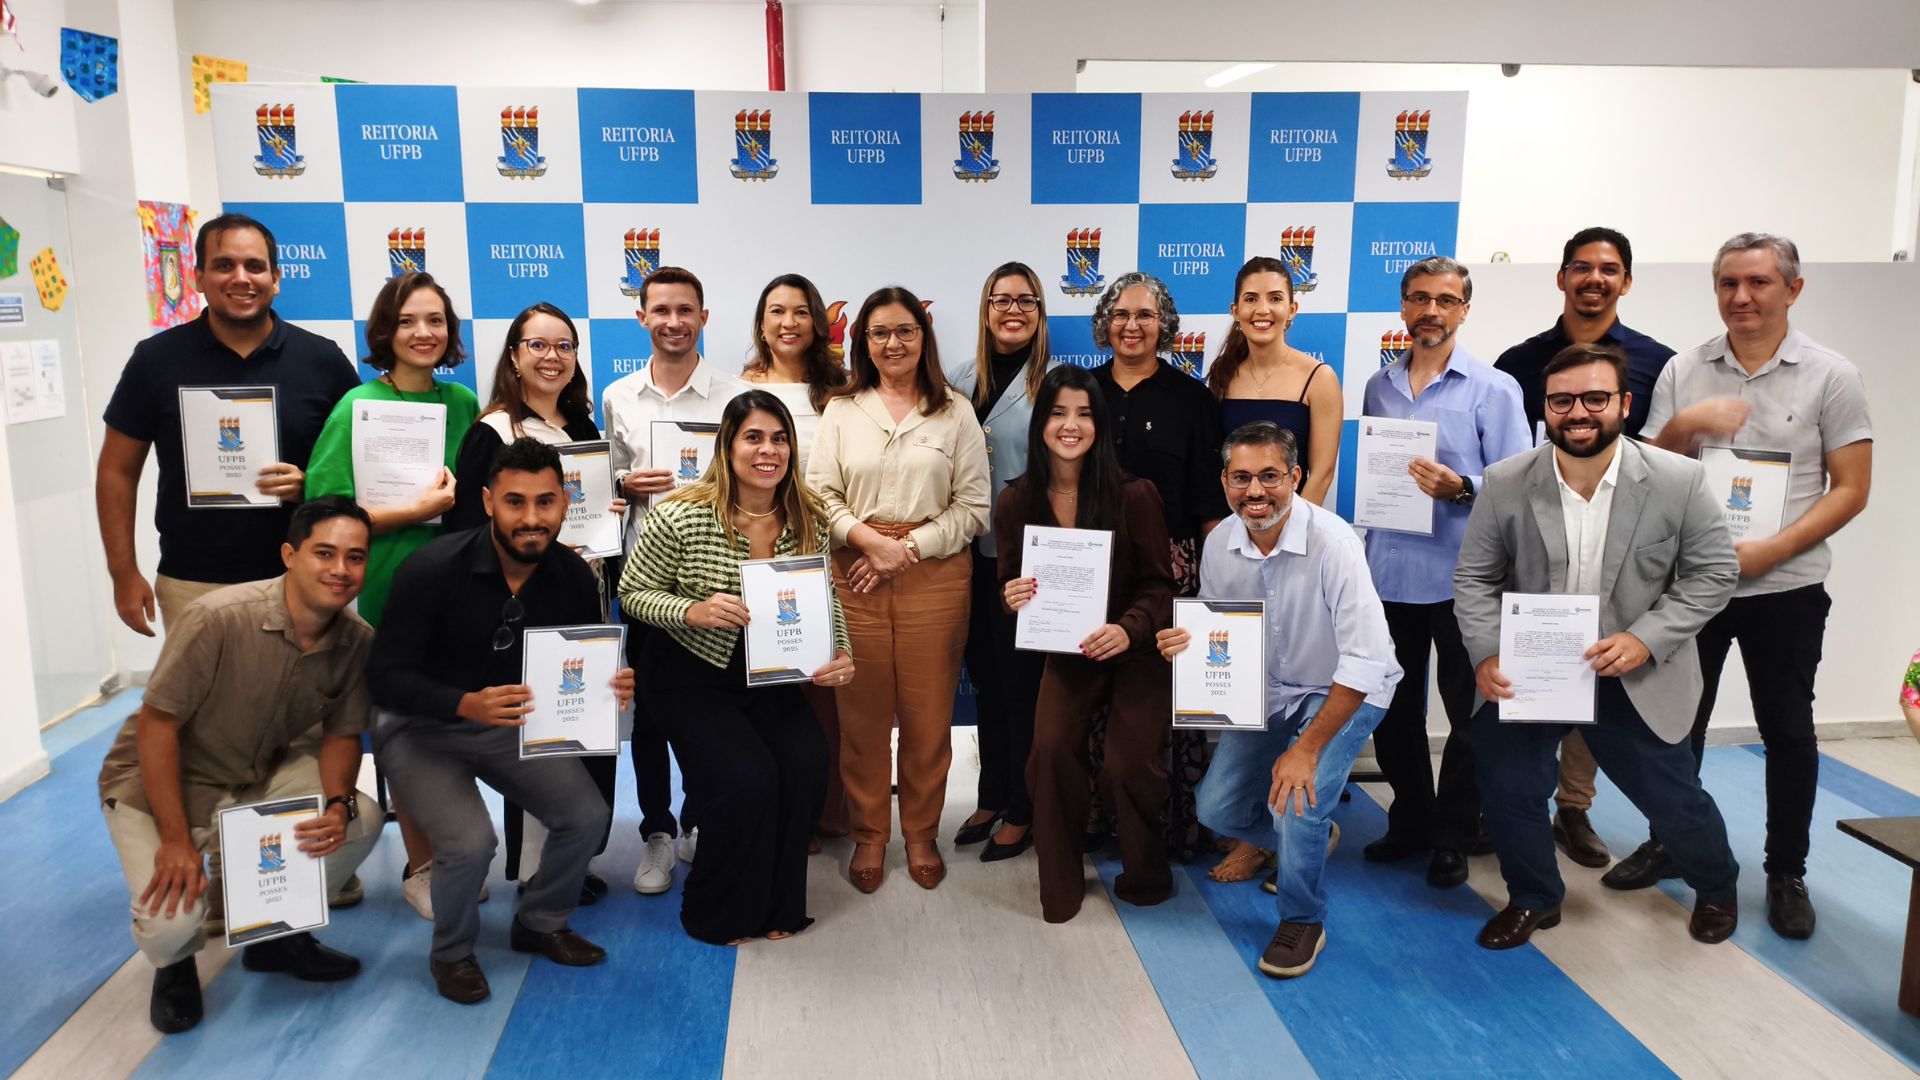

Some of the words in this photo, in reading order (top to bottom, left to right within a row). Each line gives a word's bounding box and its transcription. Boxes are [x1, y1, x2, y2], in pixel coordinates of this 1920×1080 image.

[361, 124, 439, 141] REITORIA
[601, 126, 676, 143] REITORIA
[831, 129, 902, 146] REITORIA
[1052, 129, 1121, 146] REITORIA
[1270, 129, 1339, 145] REITORIA
[380, 144, 423, 161] UFPB
[619, 146, 660, 162] UFPB
[847, 148, 886, 164] UFPB
[1067, 148, 1105, 164] UFPB
[1285, 147, 1322, 163] UFPB
[276, 243, 327, 260] TORIA
[490, 243, 566, 260] REITORIA
[1158, 242, 1226, 258] REITORIA
[1370, 240, 1438, 257] REITORIA
[277, 262, 311, 279] FPB
[508, 262, 550, 279] UFPB
[1172, 261, 1210, 276] UFPB
[613, 358, 648, 374] REIT
[217, 455, 247, 464] UFPB
[776, 628, 803, 638] UFPB
[777, 637, 804, 646] POSSES
[782, 645, 799, 653] 2025
[1205, 671, 1232, 680] UFPB
[557, 697, 585, 708] UFPB
[556, 707, 585, 716] POSSES
[258, 875, 287, 889] UFPB
